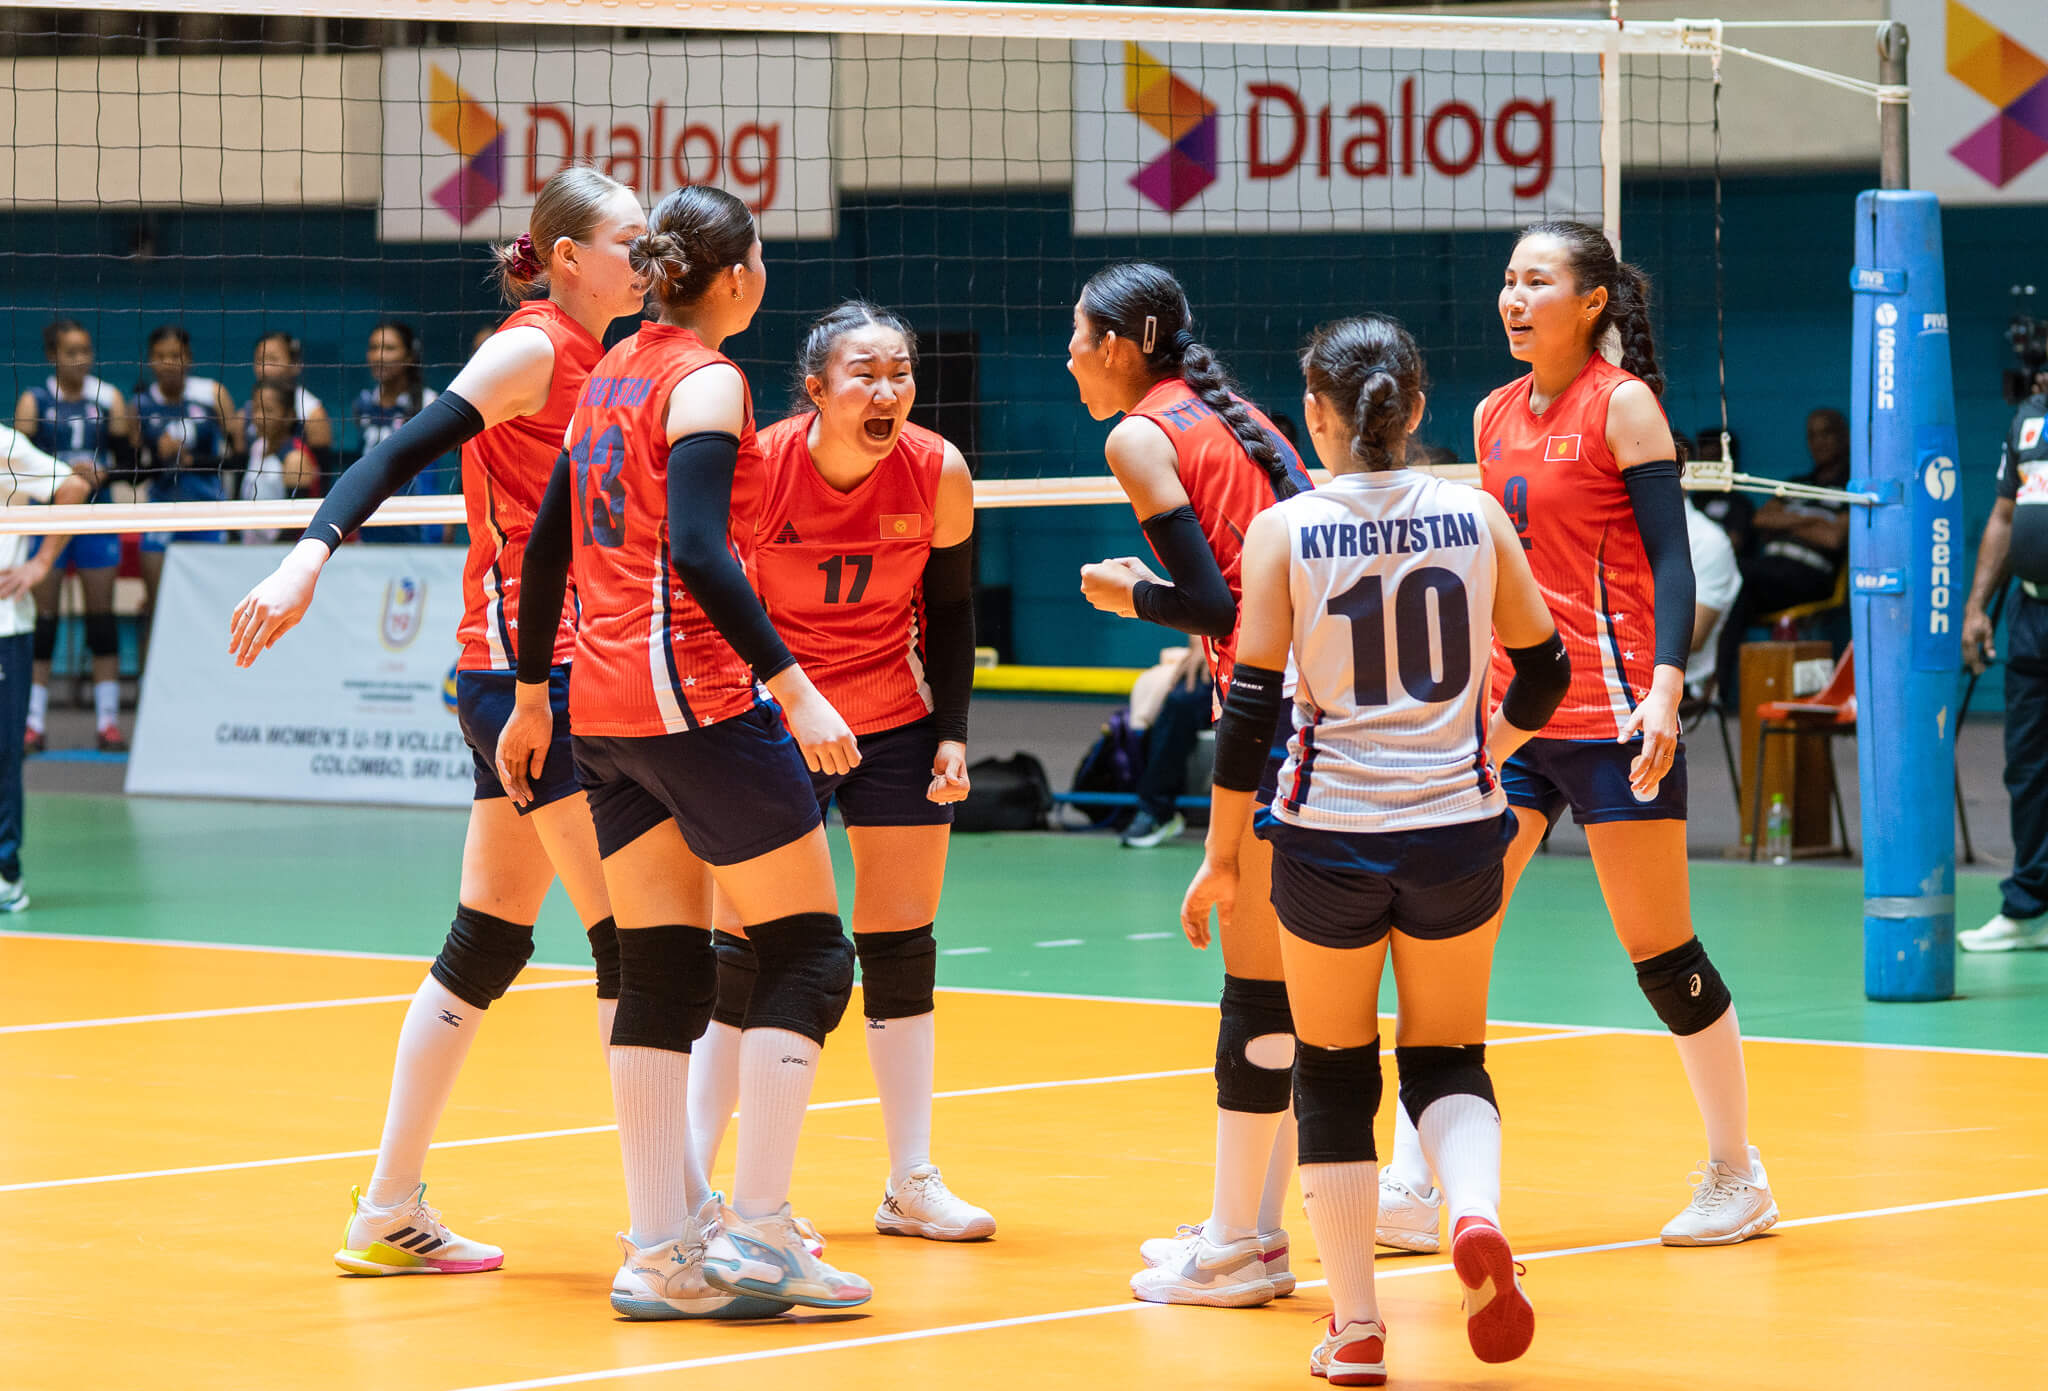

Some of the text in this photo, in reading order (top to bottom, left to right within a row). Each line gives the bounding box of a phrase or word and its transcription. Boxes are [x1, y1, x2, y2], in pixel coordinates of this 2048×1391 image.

[525, 100, 781, 213] Dialog
[1245, 76, 1556, 199] Dialog
[570, 424, 626, 547] 13
[1504, 476, 1528, 534] 9
[1301, 512, 1480, 559] KYRGYZSTAN
[818, 555, 873, 603] 17
[1327, 566, 1471, 707] 10
[215, 724, 261, 744] CAVA
[266, 725, 347, 748] WOMEN'S
[353, 729, 391, 749] U-19
[411, 758, 439, 779] SRI
